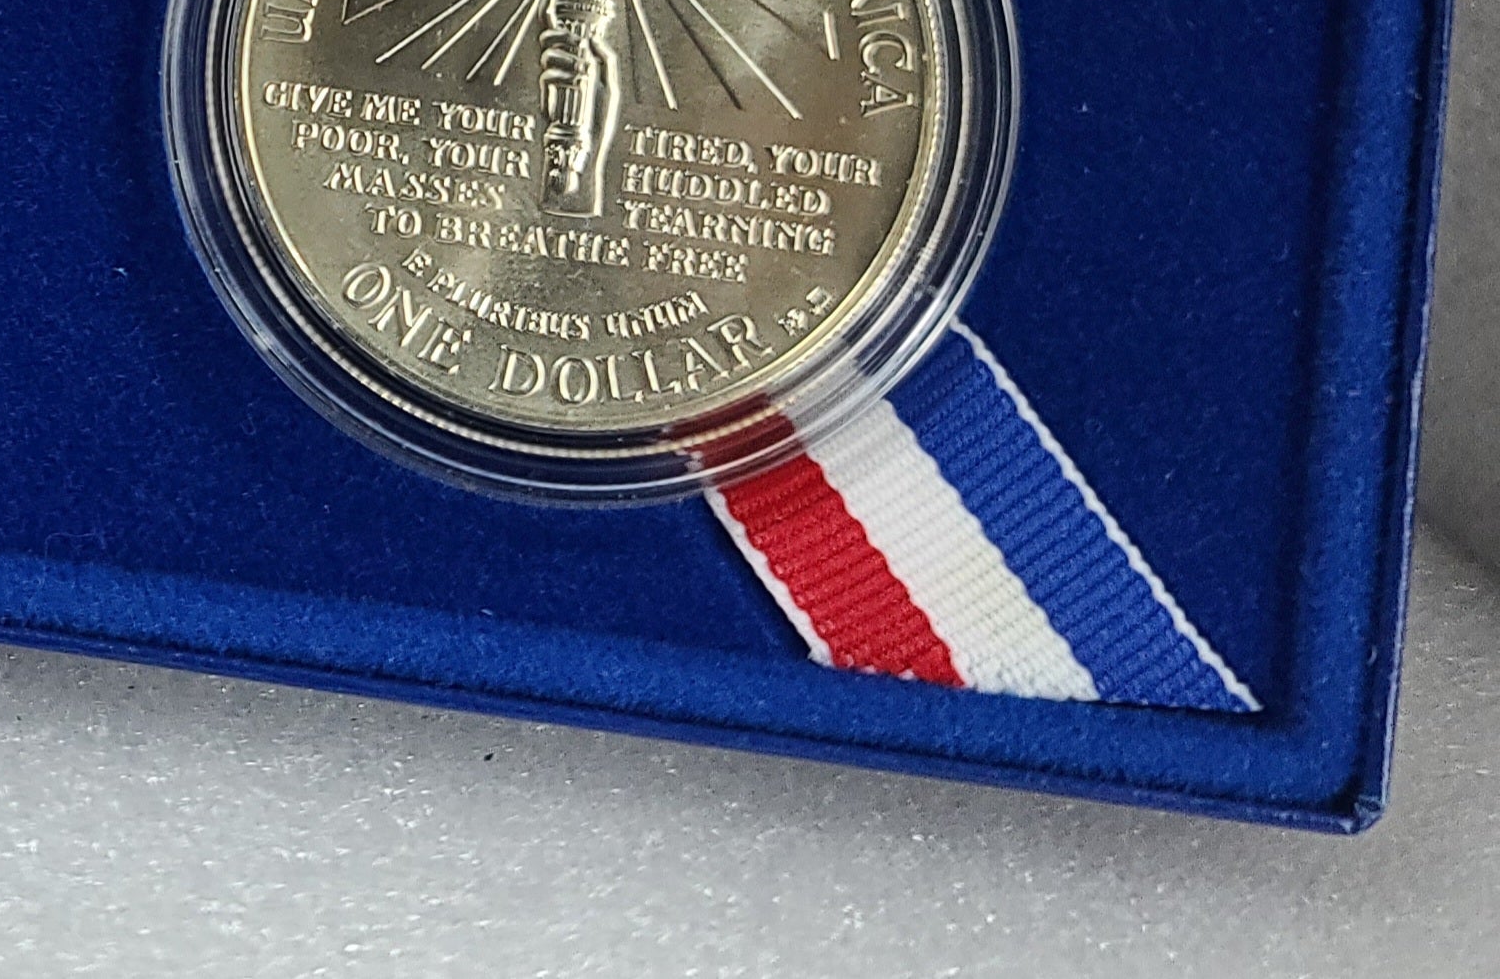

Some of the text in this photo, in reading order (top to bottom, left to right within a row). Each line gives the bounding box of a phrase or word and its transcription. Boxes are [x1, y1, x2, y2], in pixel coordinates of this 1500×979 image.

[262, 81, 536, 142] GIVE ME YOUR
[291, 119, 531, 179] POOR, YOUR
[624, 123, 882, 187] TIRED, YOUR
[322, 162, 506, 210] MASSES
[621, 163, 832, 216] HUDDLED
[363, 201, 748, 284] TO BREATHE FREE
[615, 198, 836, 257] YEARNING
[402, 248, 711, 342] E PLURIBUS UNUM
[340, 262, 776, 407] ONE DOLLAR
